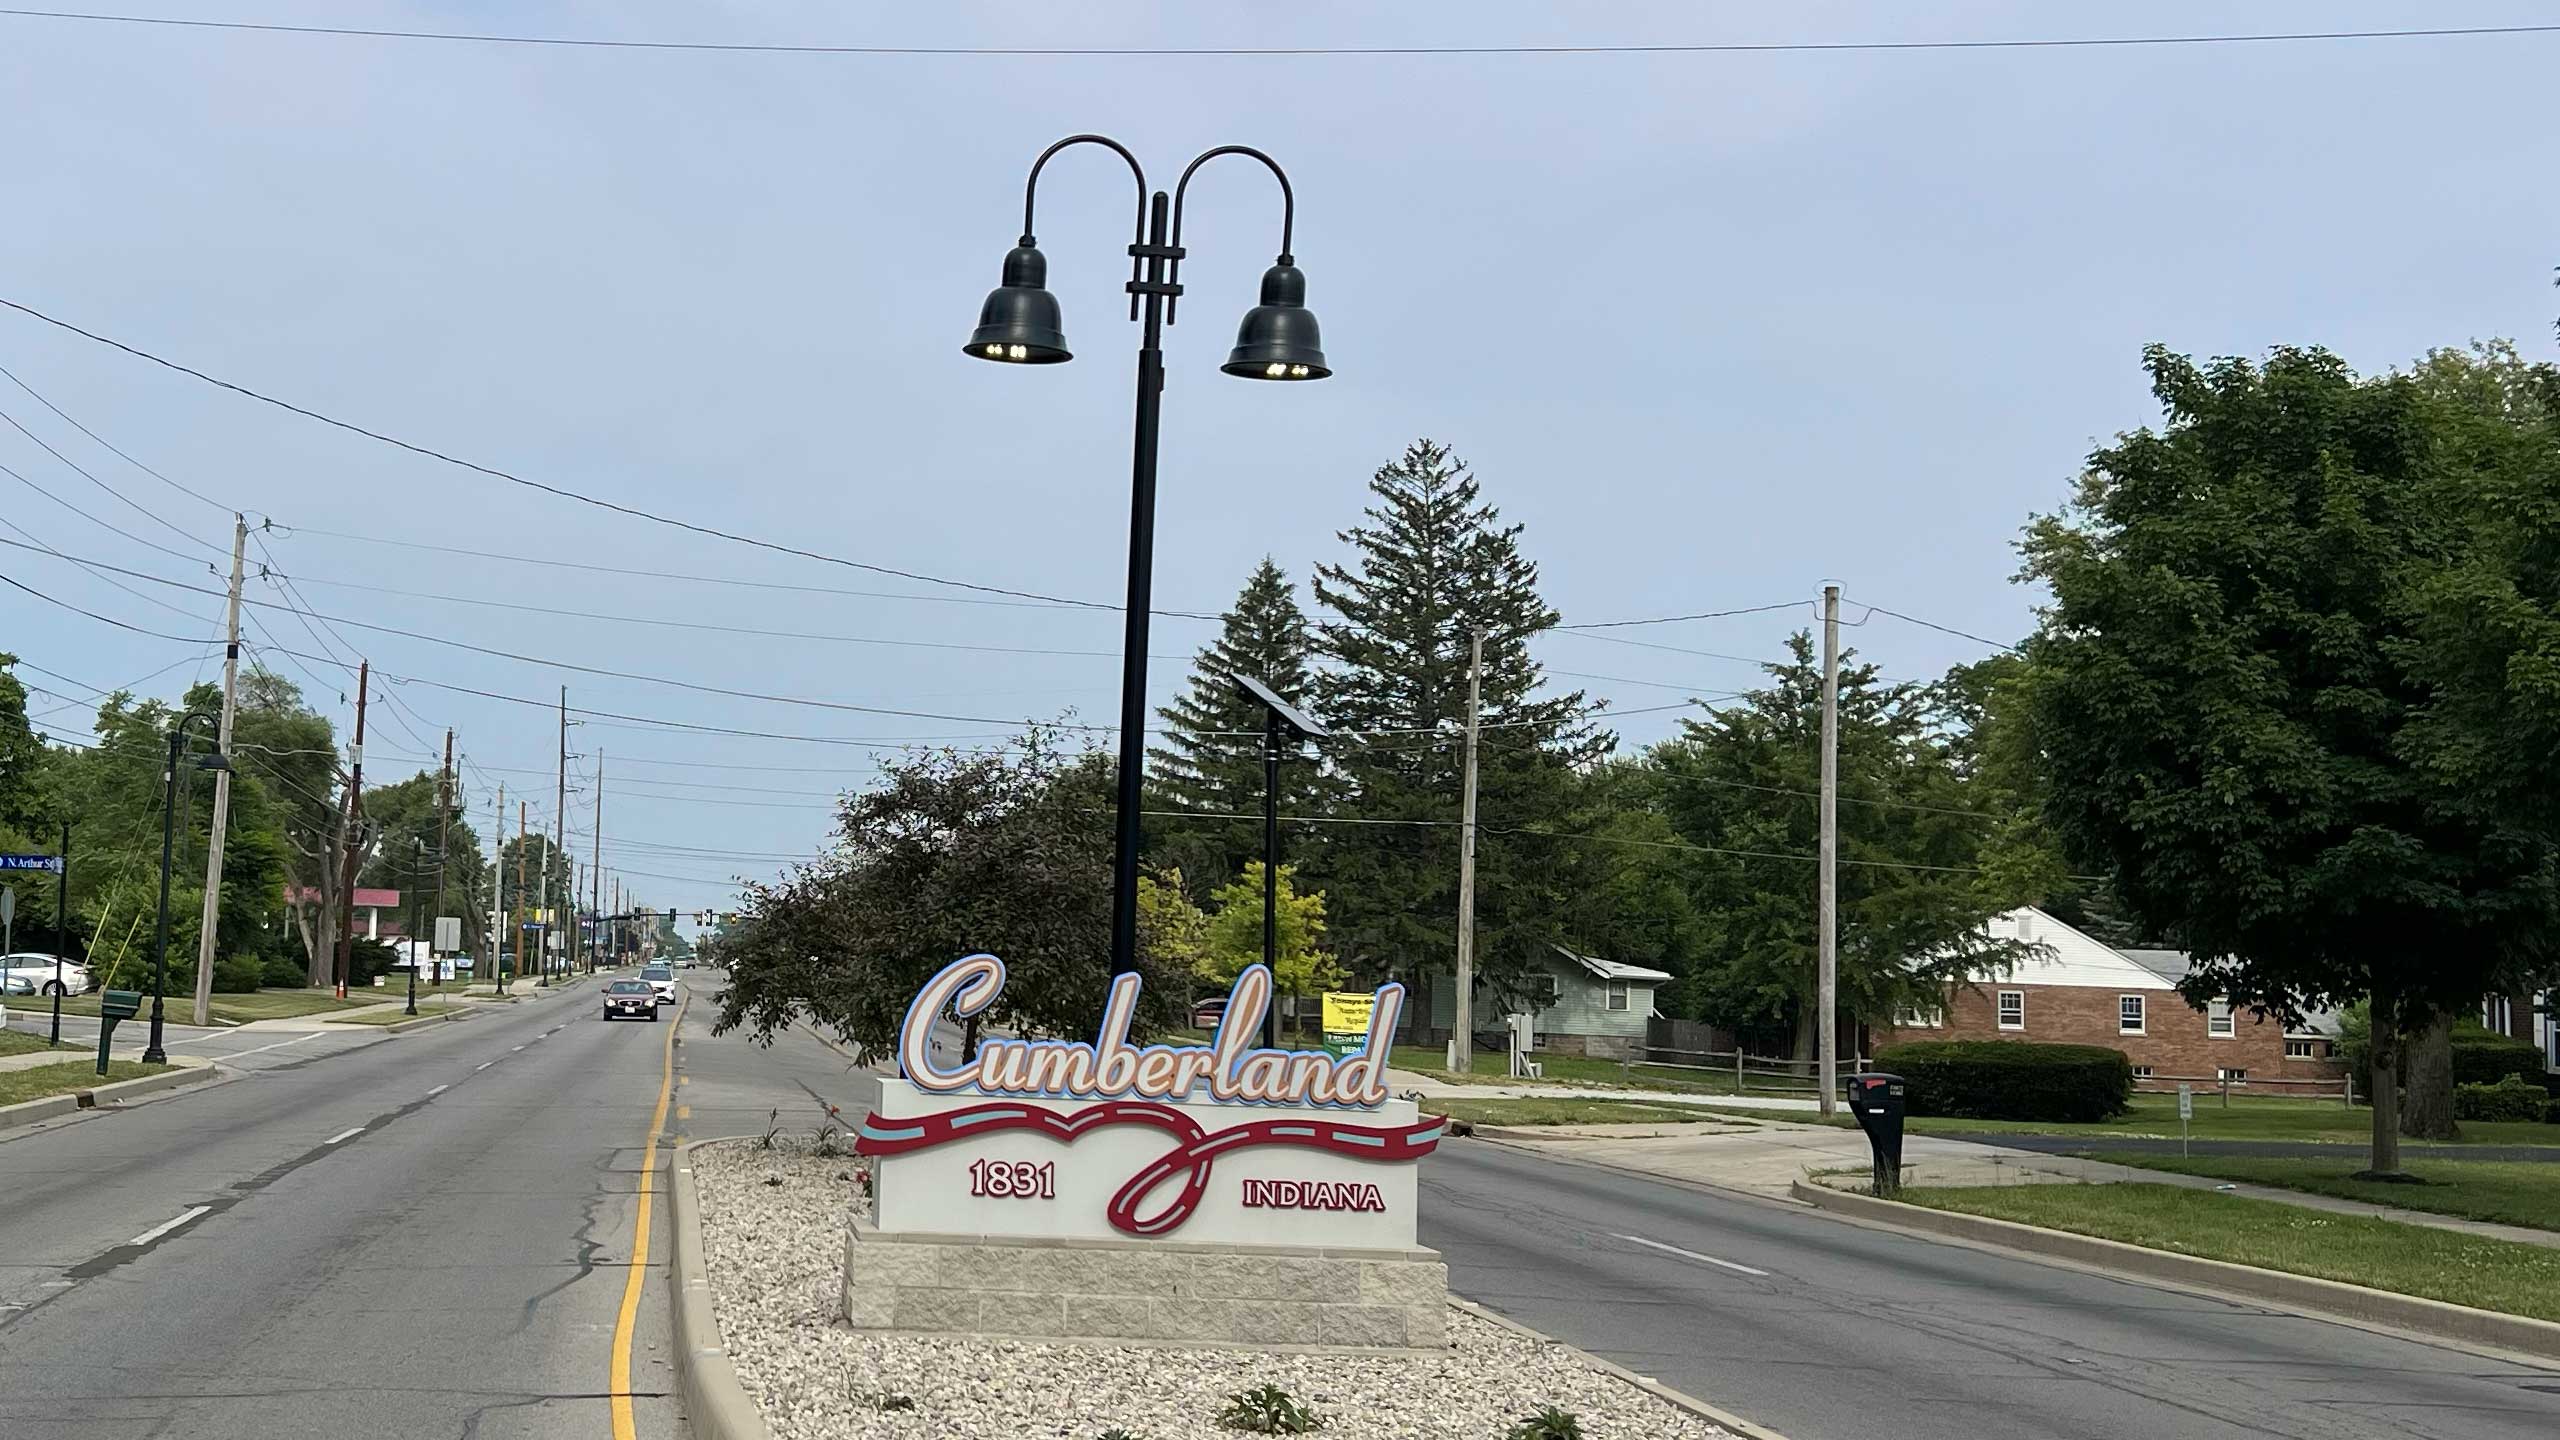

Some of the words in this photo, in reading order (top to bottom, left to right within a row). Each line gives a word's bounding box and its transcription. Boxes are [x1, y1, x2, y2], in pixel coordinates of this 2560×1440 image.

[18, 857, 44, 868] Arthur
[900, 953, 1405, 1109] Cumberland
[970, 1158, 1055, 1198] 1831
[1242, 1179, 1386, 1212] INDIANA
